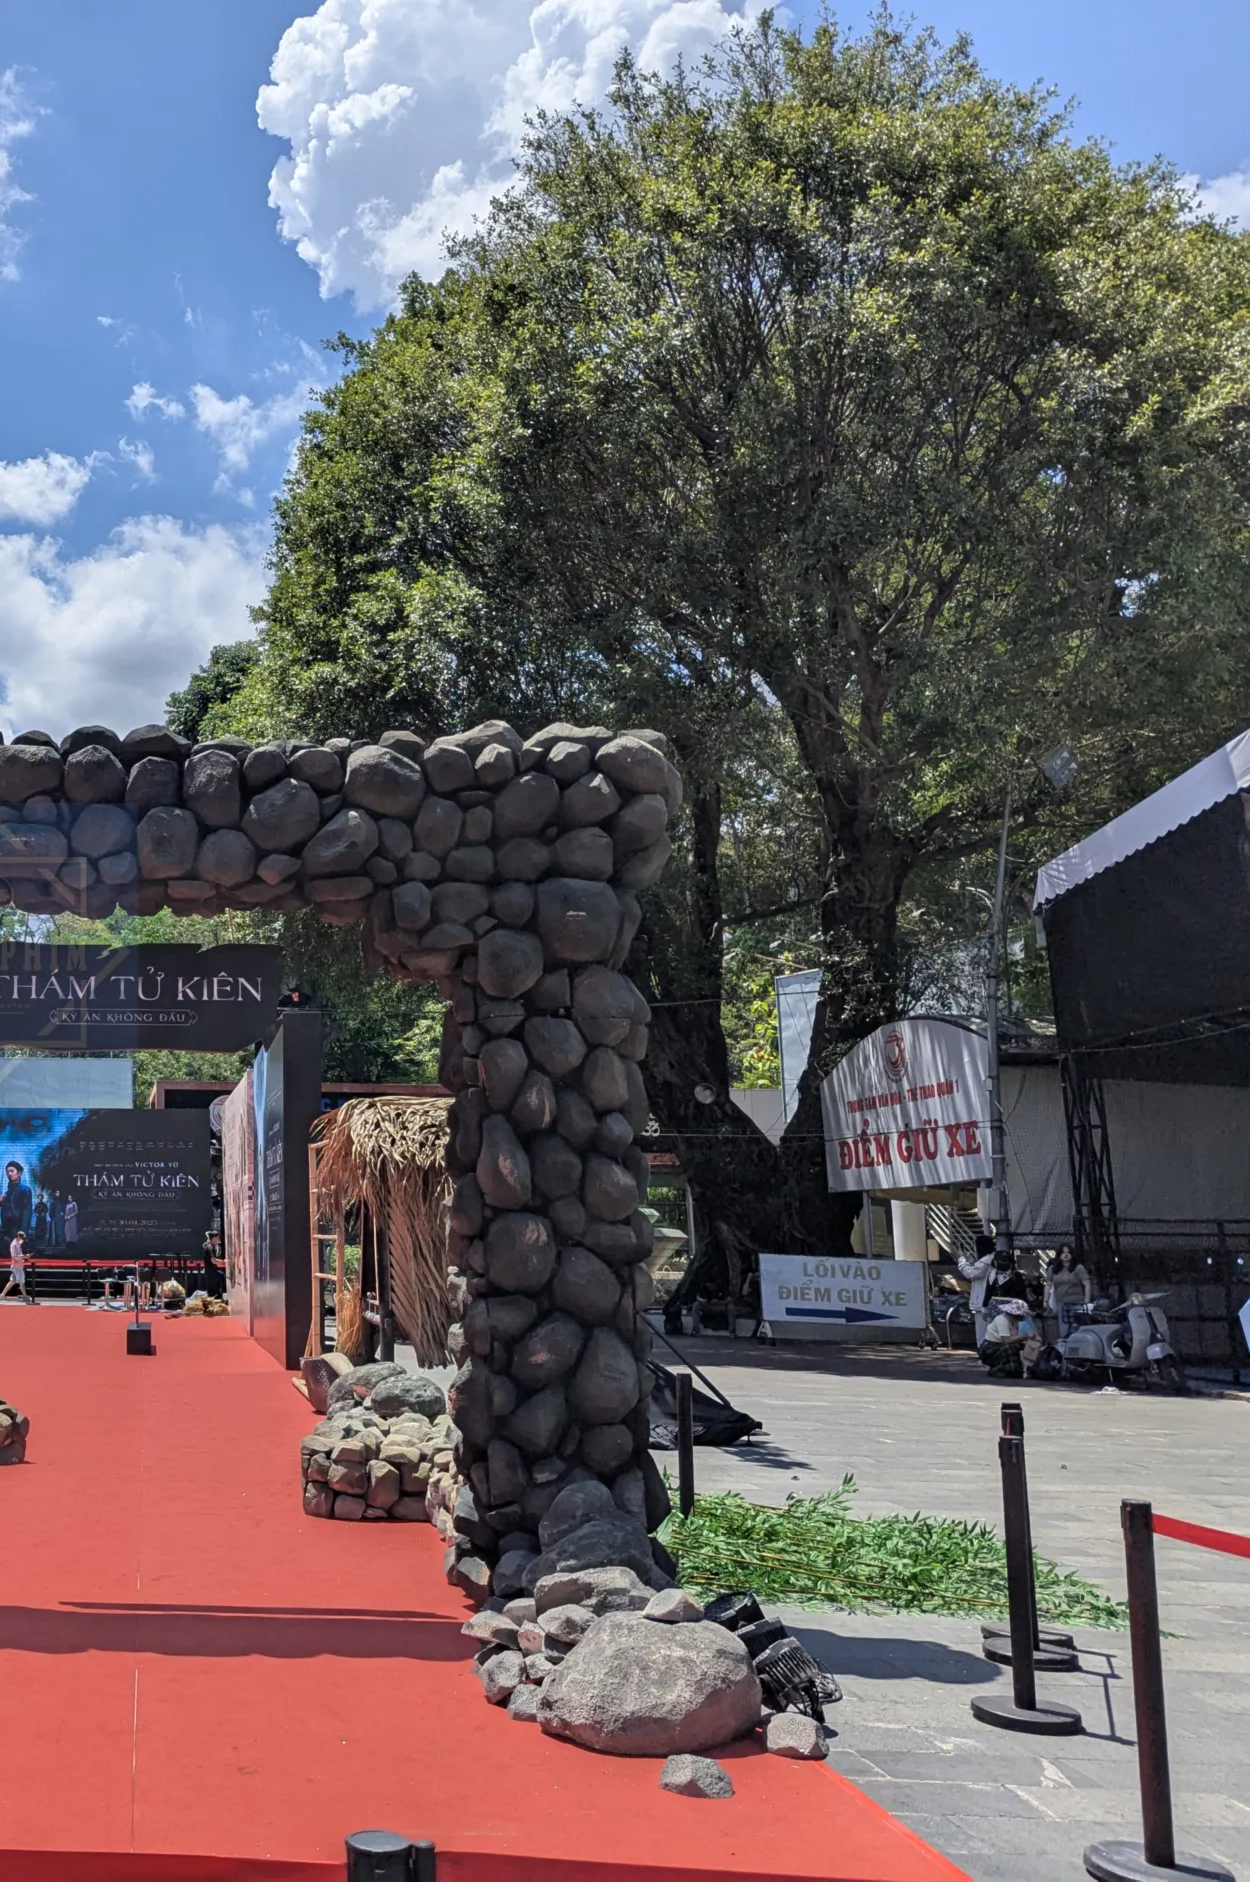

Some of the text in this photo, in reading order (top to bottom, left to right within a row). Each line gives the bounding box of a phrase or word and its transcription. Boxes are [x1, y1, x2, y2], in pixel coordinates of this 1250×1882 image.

[110, 966, 165, 1000] TỬ
[176, 971, 263, 1002] KIÊN
[83, 1011, 101, 1022] ÁN
[106, 1010, 153, 1023] KHÔNG
[919, 1084, 936, 1100] THAO
[838, 1118, 982, 1170] ĐIỂM GIỮ XE
[73, 1170, 199, 1188] THÁM TỬ KIÊN
[125, 1190, 155, 1198] KHÔNG
[802, 1258, 881, 1281] LỐI VÀO
[777, 1279, 907, 1307] ĐIỂM GIỮ XE
